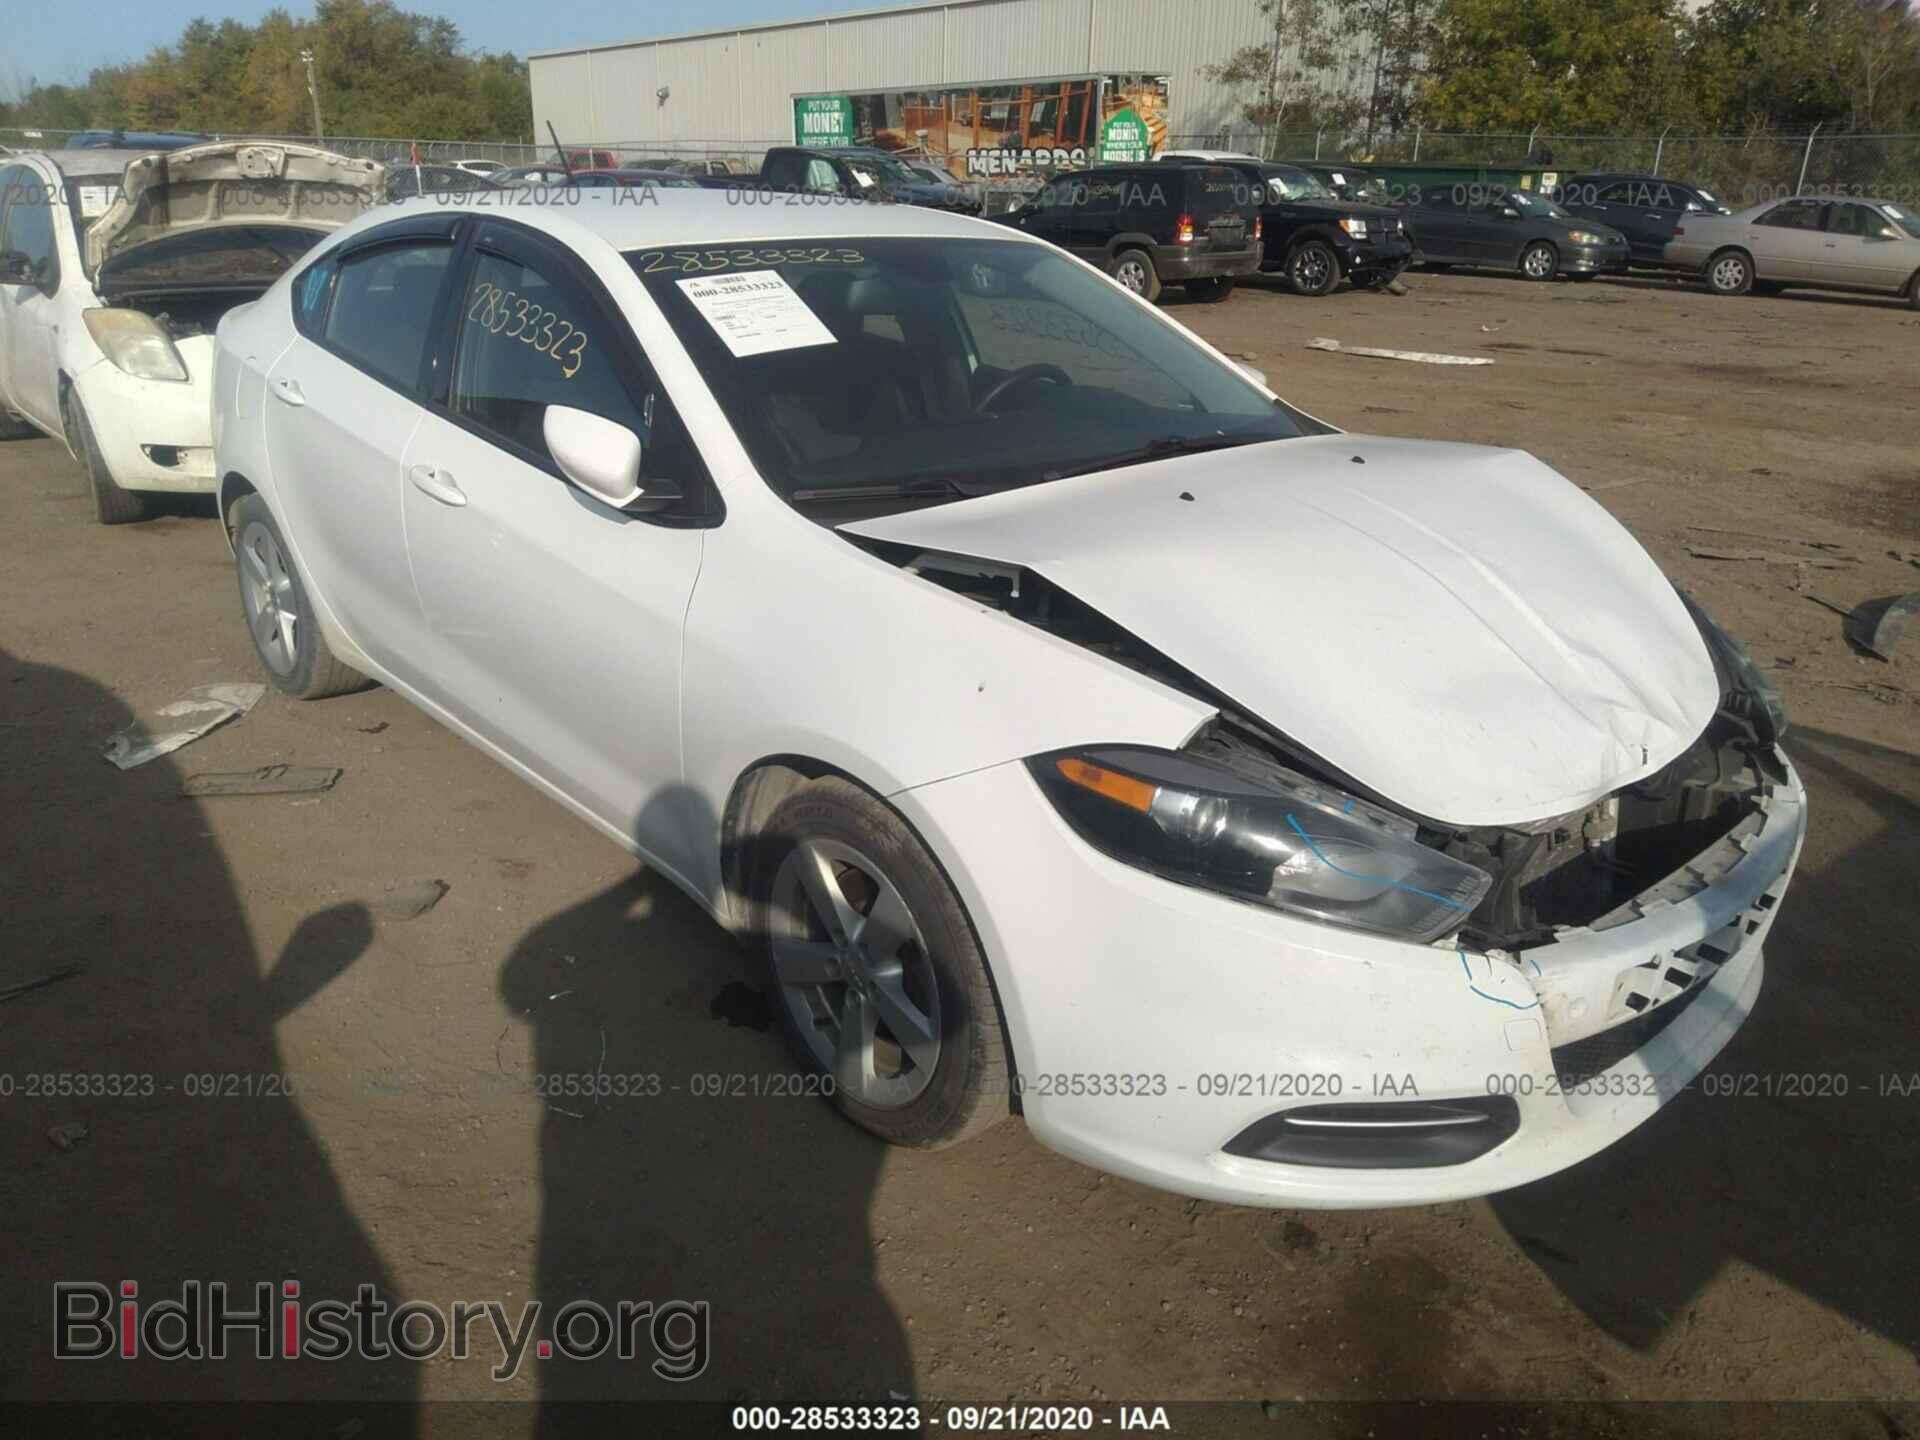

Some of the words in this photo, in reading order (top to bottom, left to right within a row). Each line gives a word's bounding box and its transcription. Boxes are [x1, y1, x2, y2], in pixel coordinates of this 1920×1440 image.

[803, 112, 845, 133] MONEY
[640, 249, 865, 273] 28533323
[469, 283, 587, 378] 28533323
